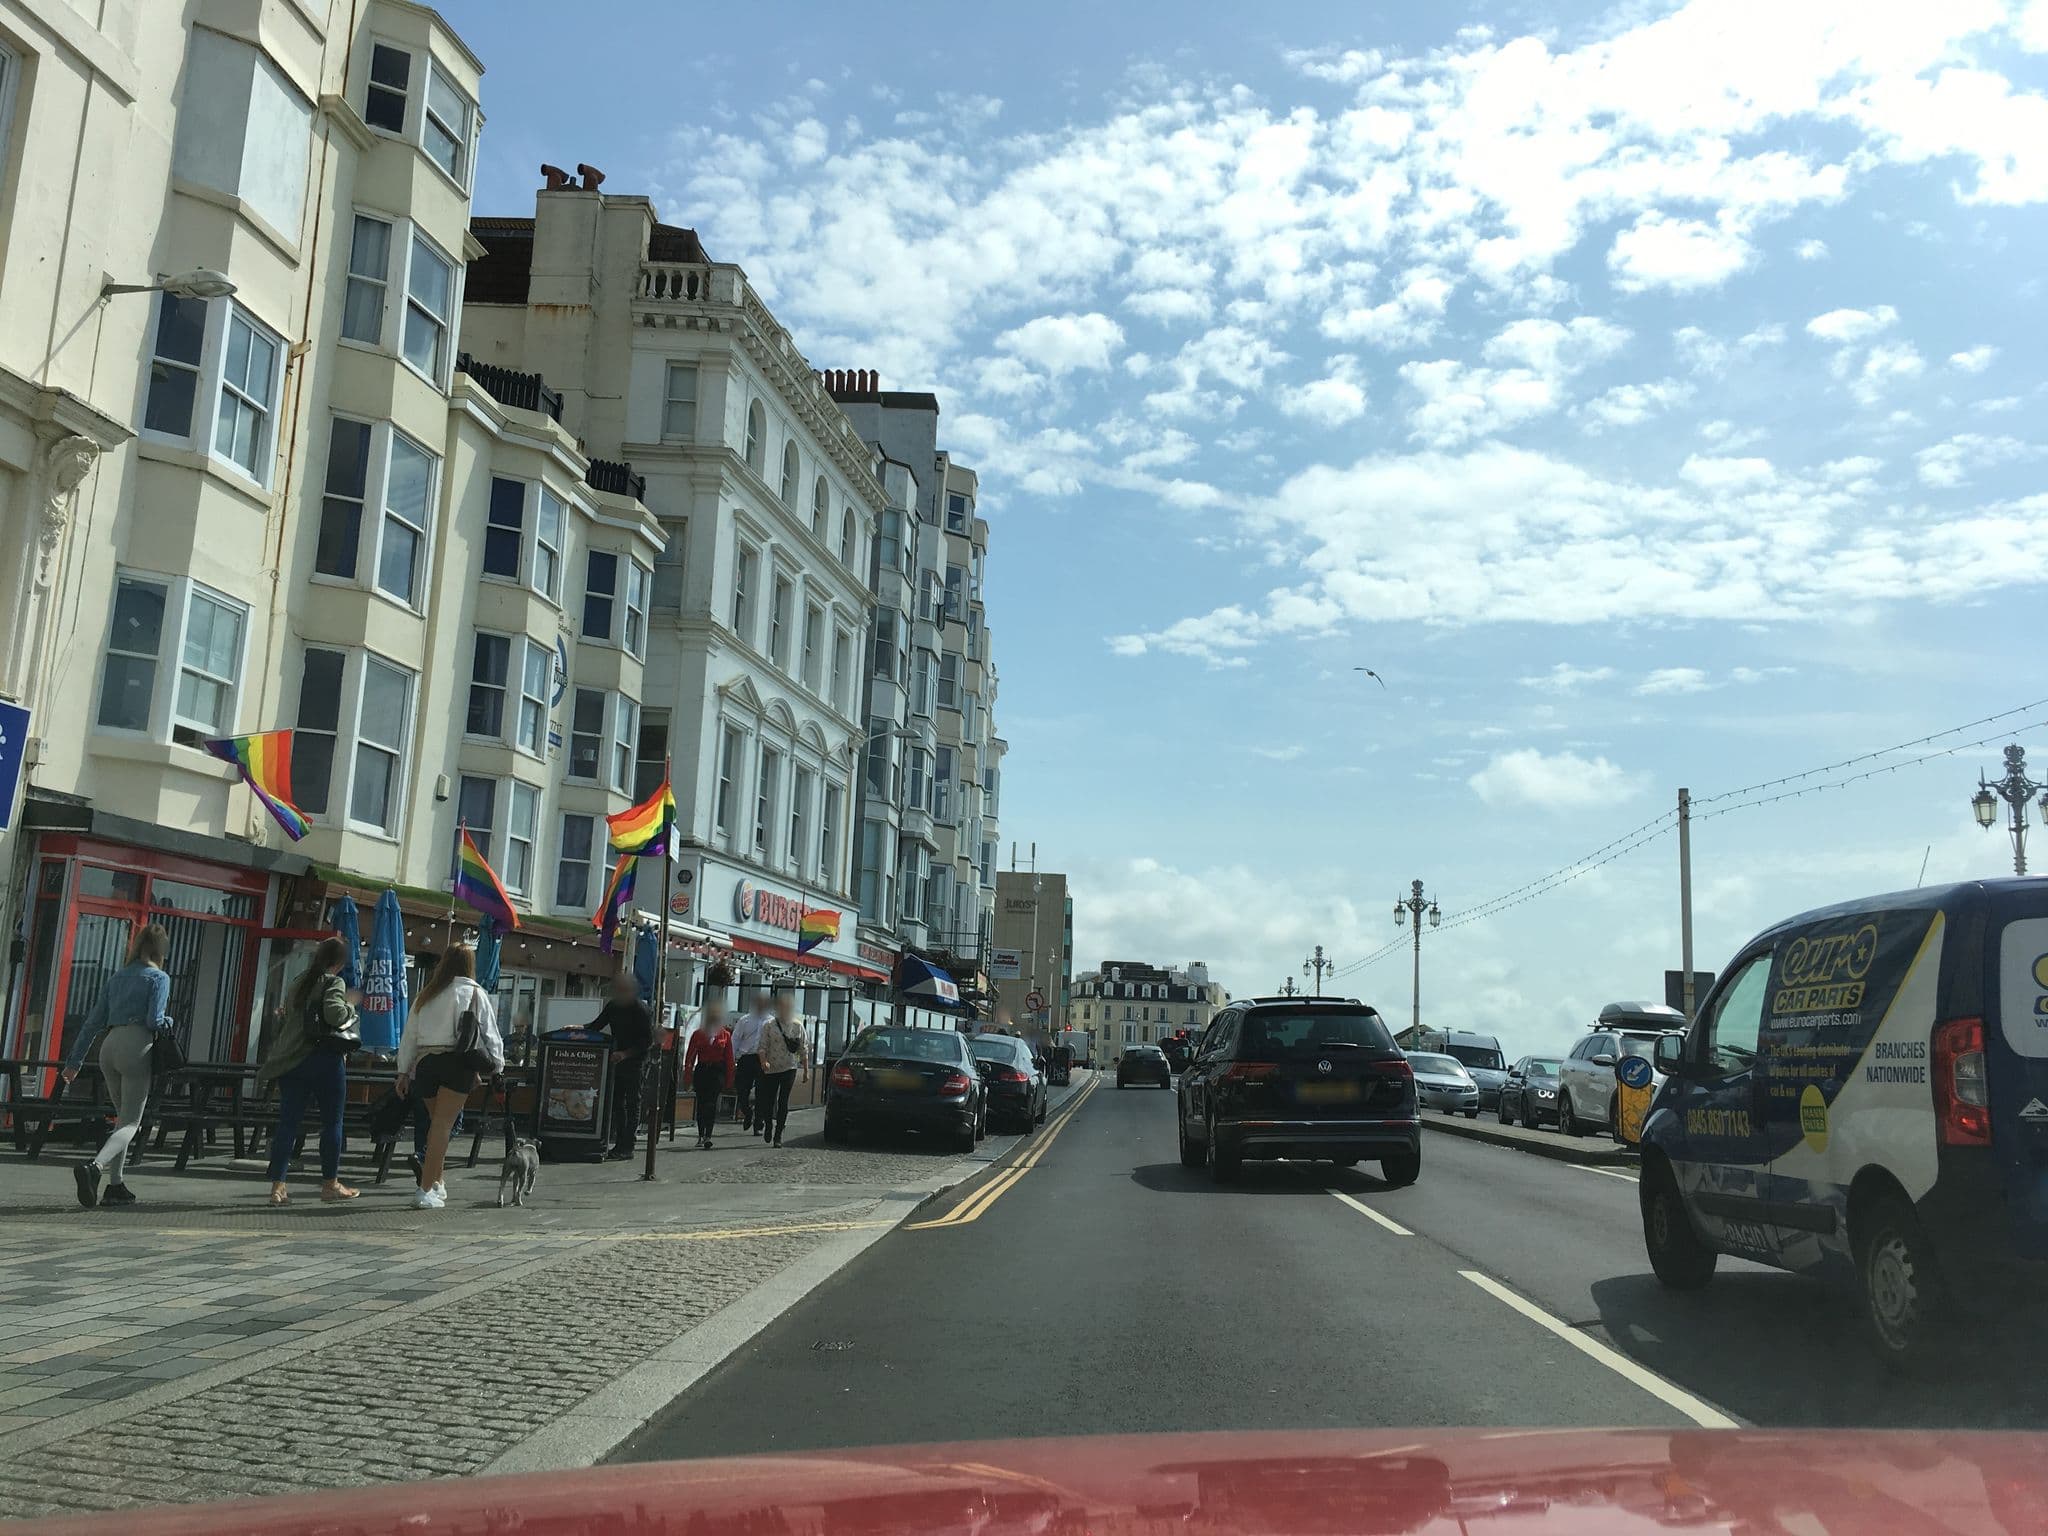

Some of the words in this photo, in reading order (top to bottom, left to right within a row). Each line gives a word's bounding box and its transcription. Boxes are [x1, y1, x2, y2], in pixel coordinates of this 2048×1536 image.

[369, 959, 393, 976] AST
[365, 976, 393, 995] oas
[368, 996, 388, 1011] IPA
[1778, 989, 1806, 1011] CAR
[1807, 984, 1860, 1008] PARTS
[1770, 1012, 1861, 1029] www.eurocarparts.com
[555, 1050, 570, 1058] Fish
[576, 1051, 596, 1060] Chips
[1875, 1041, 1926, 1060] BRANCHES
[1866, 1066, 1926, 1083] NATIONWIDE
